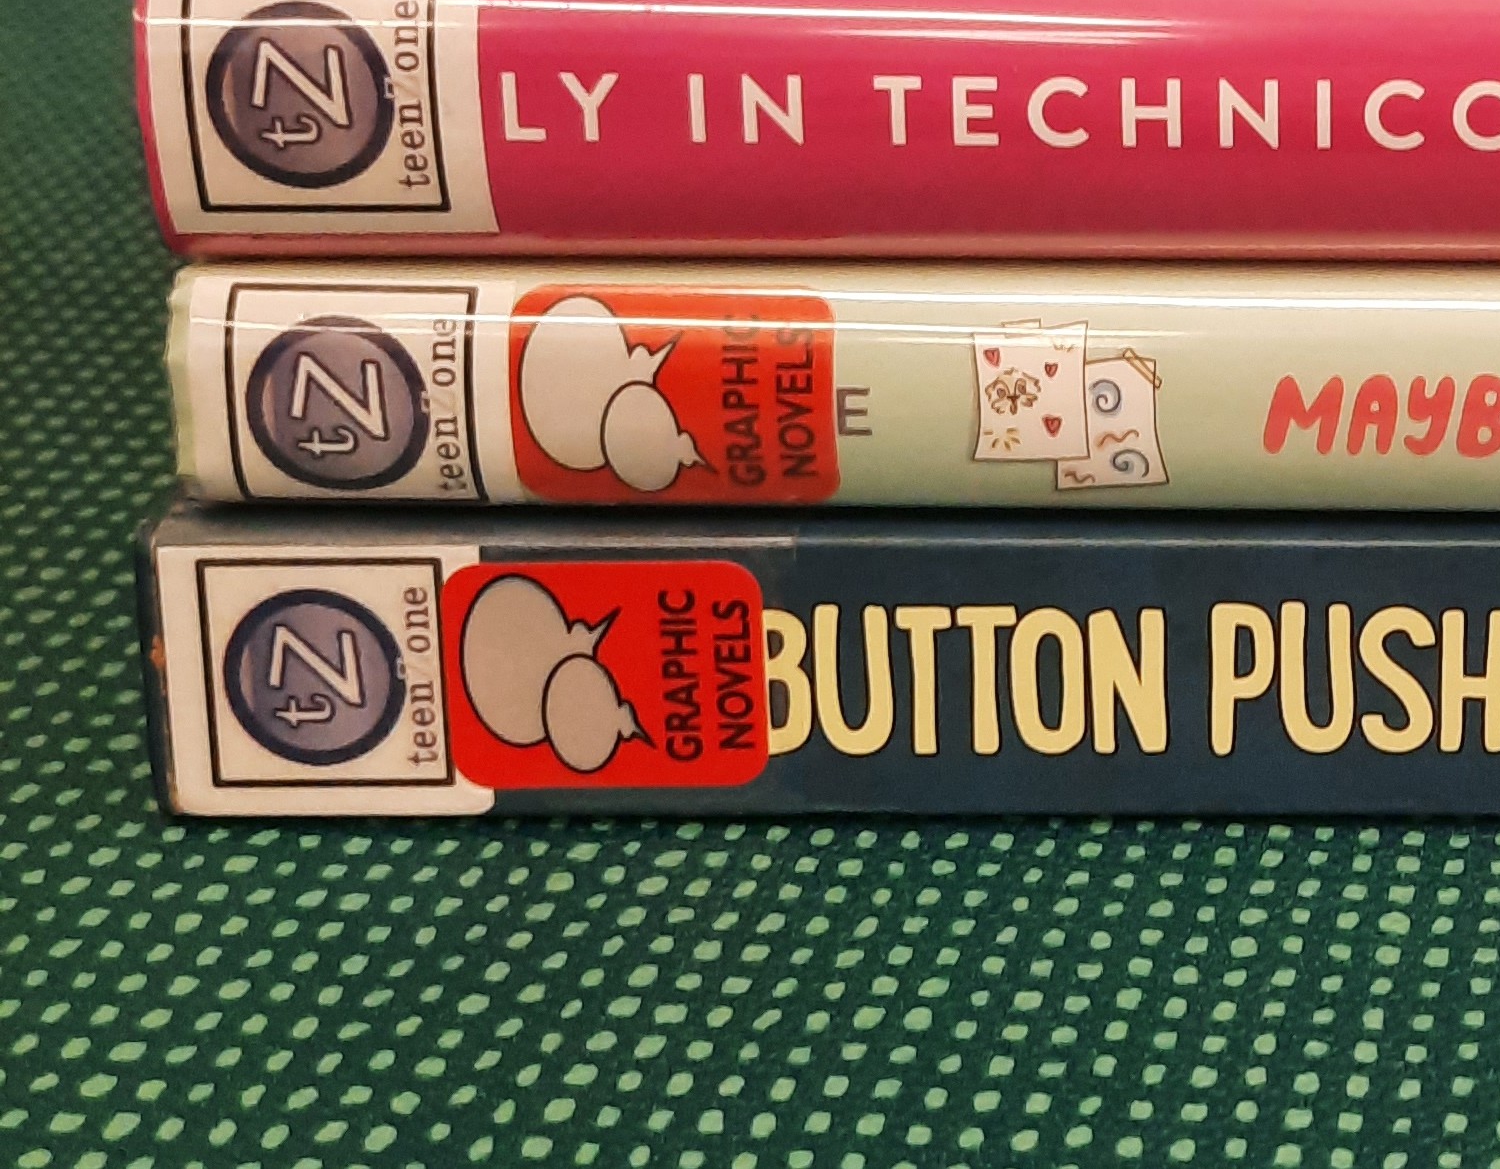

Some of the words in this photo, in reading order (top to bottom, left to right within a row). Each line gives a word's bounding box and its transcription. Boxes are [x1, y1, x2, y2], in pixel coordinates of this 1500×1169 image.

[500, 71, 618, 144] LY
[687, 73, 804, 146] IN
[721, 313, 767, 488] GRAPHIC
[775, 324, 820, 479] NOVELS
[657, 589, 704, 763] GRAPHIC
[718, 598, 756, 751] NOVELS
[762, 602, 1170, 758] BUTTON
